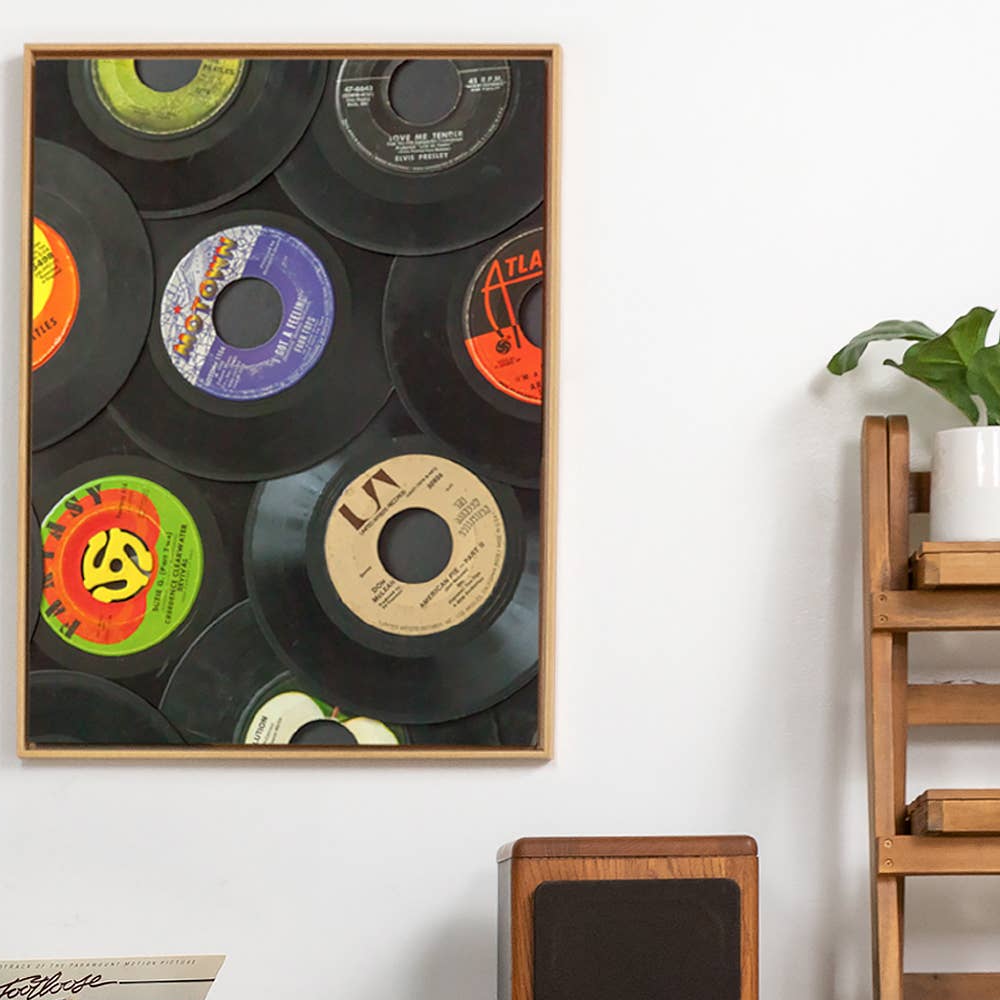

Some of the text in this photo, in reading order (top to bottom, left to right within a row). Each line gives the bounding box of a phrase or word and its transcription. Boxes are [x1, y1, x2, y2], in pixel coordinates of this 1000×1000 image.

[389, 134, 411, 142] LOVE
[415, 132, 427, 140] ME
[395, 152, 449, 162] ELVIS PRESLEY
[173, 236, 237, 360] MOTOWN
[419, 578, 450, 608] AMERICAN
[464, 547, 481, 564] PART
[371, 579, 387, 594] DON
